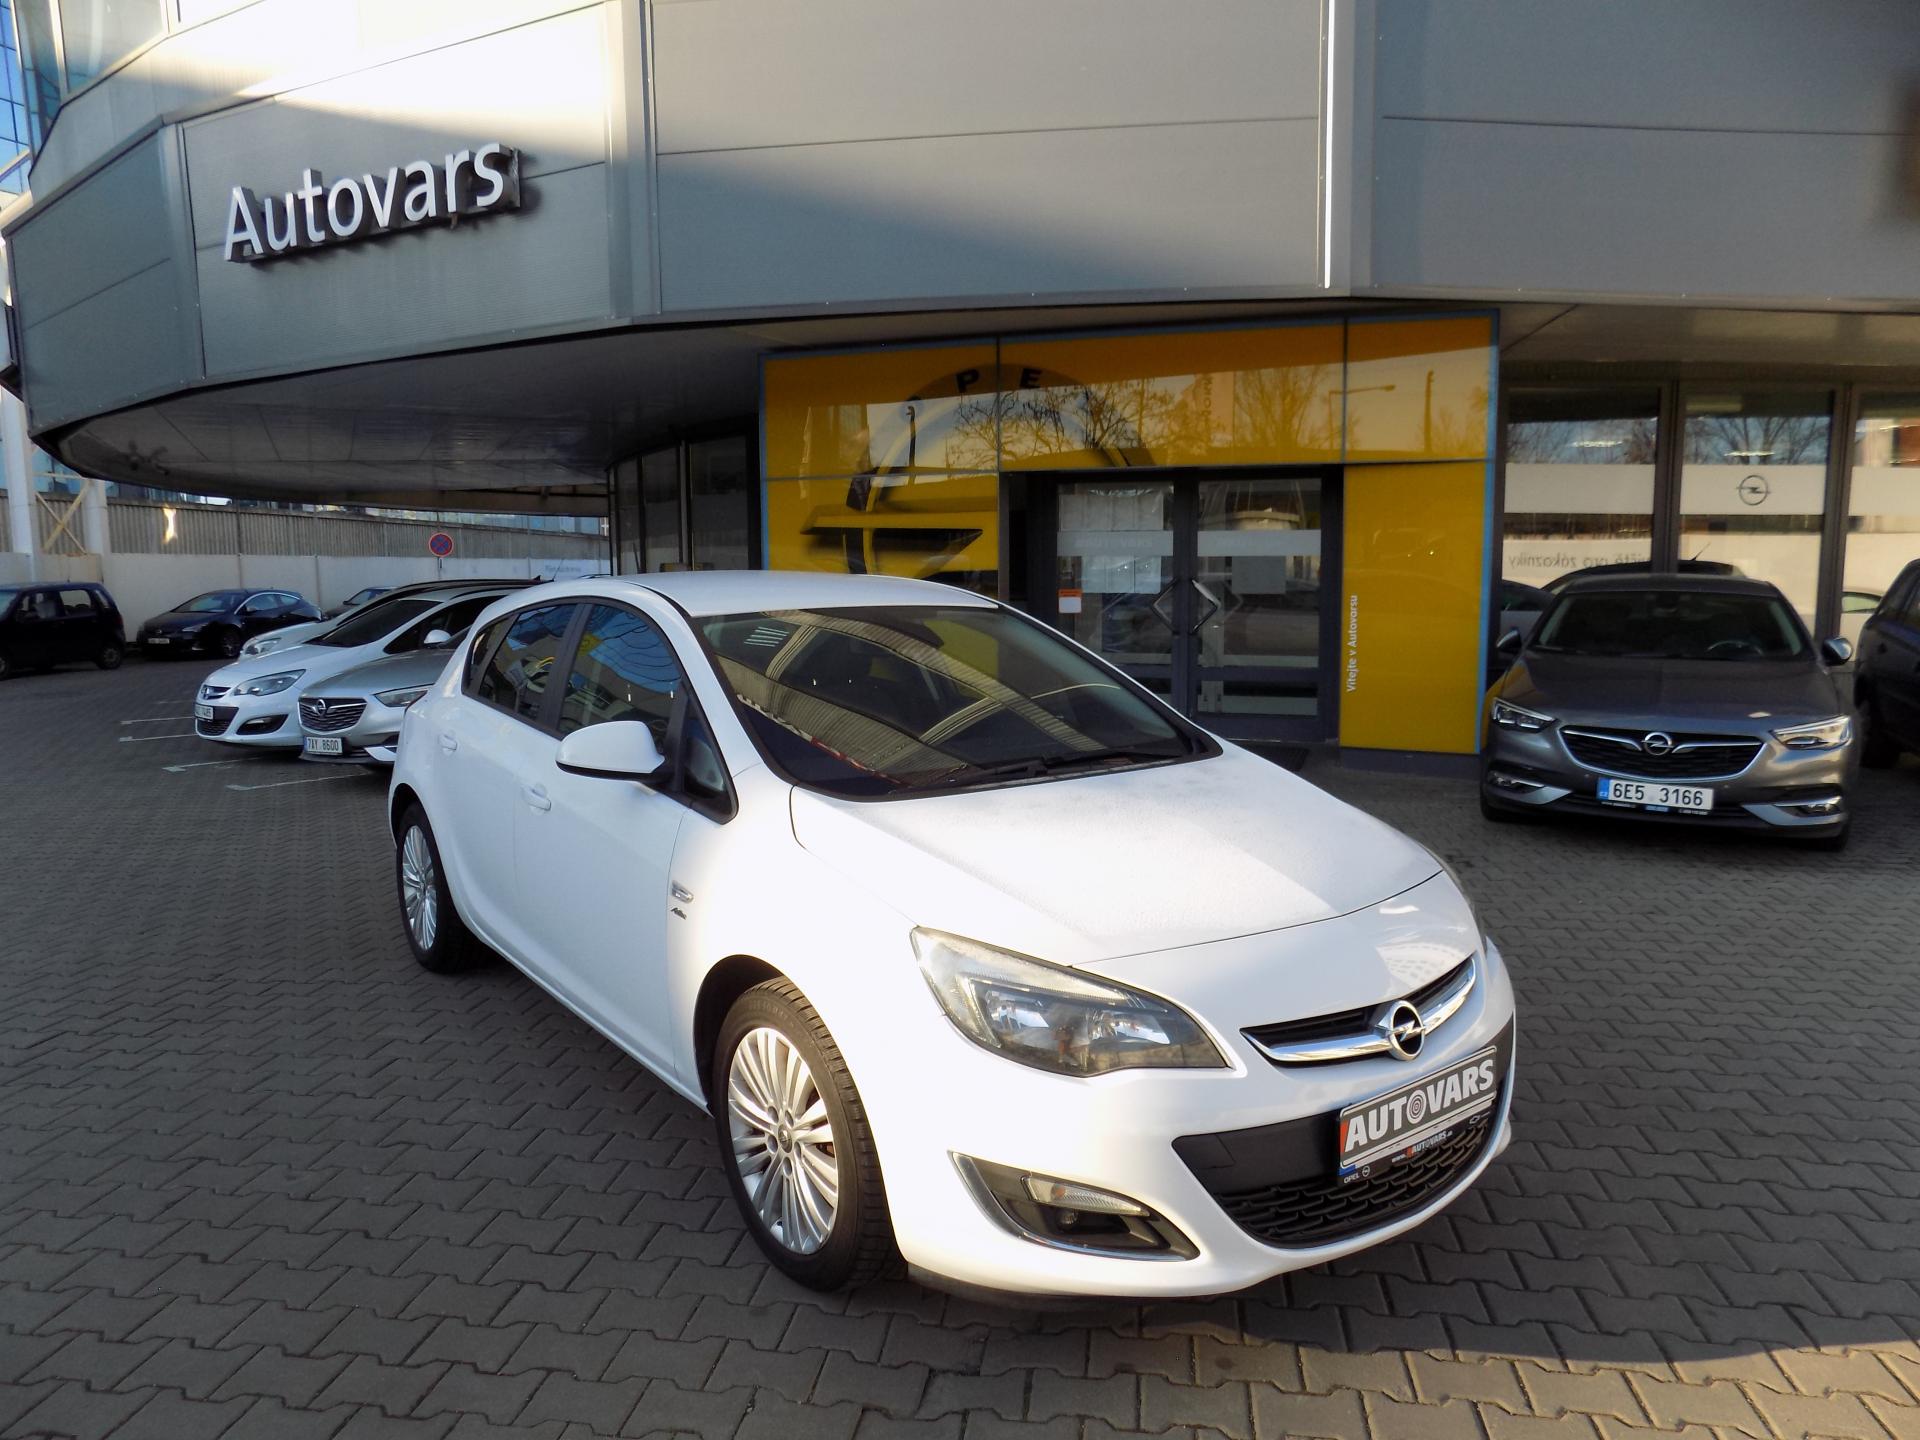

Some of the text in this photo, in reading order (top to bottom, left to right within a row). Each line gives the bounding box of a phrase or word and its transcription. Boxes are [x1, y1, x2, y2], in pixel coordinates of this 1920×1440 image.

[224, 143, 505, 261] Autovars
[1347, 595, 1358, 648] Autovarsu
[1613, 783, 1704, 806] 6E5 3166
[1344, 1059, 1494, 1153] AUTOVARS
[1343, 1173, 1360, 1184] OPEL
